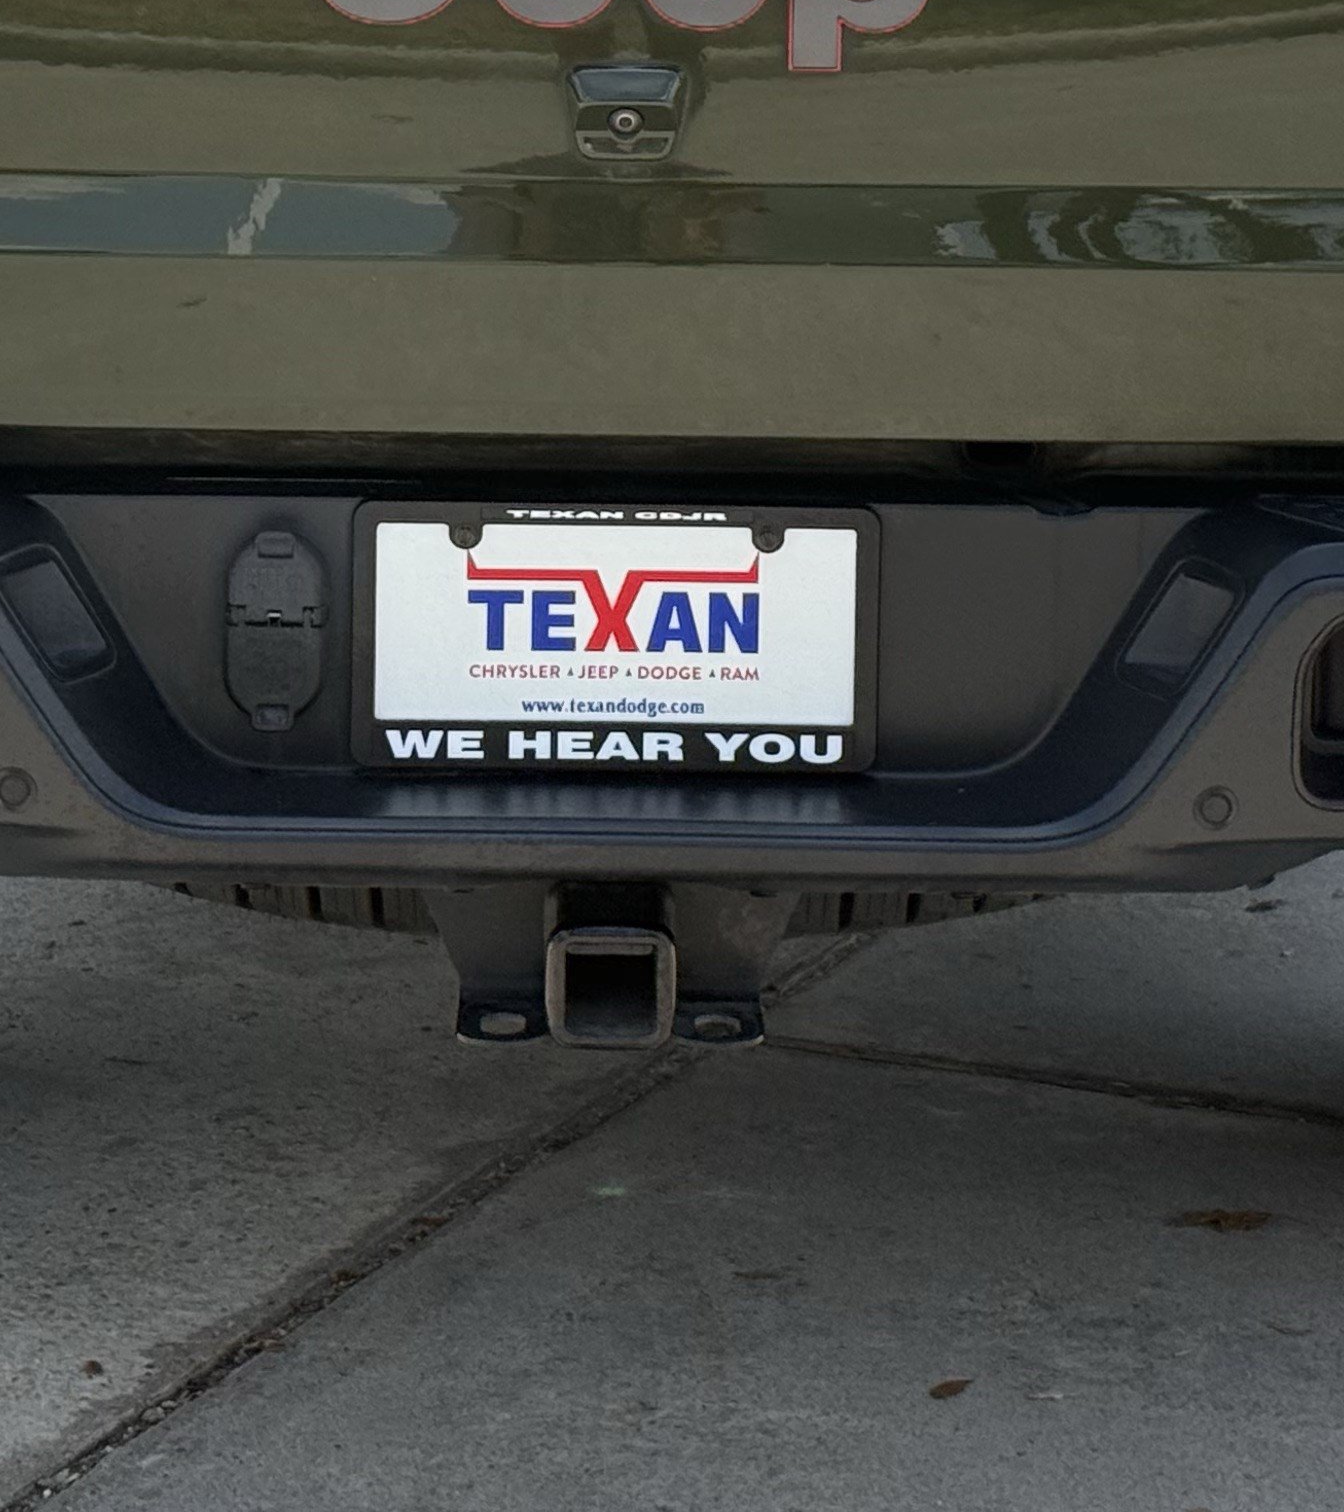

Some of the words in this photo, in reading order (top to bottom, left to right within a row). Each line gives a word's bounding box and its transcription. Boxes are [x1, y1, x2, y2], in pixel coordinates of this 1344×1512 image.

[506, 509, 625, 520] TEXAN
[467, 571, 760, 655] TEXAN
[468, 663, 561, 679] CHRYSLER
[578, 665, 619, 679] JEEP
[637, 665, 702, 680] DODGE
[720, 666, 760, 681] RAM
[521, 697, 705, 716] www.texandodge.com
[385, 729, 484, 759] WE
[508, 731, 684, 761] HEAR
[705, 733, 844, 764] YOU
